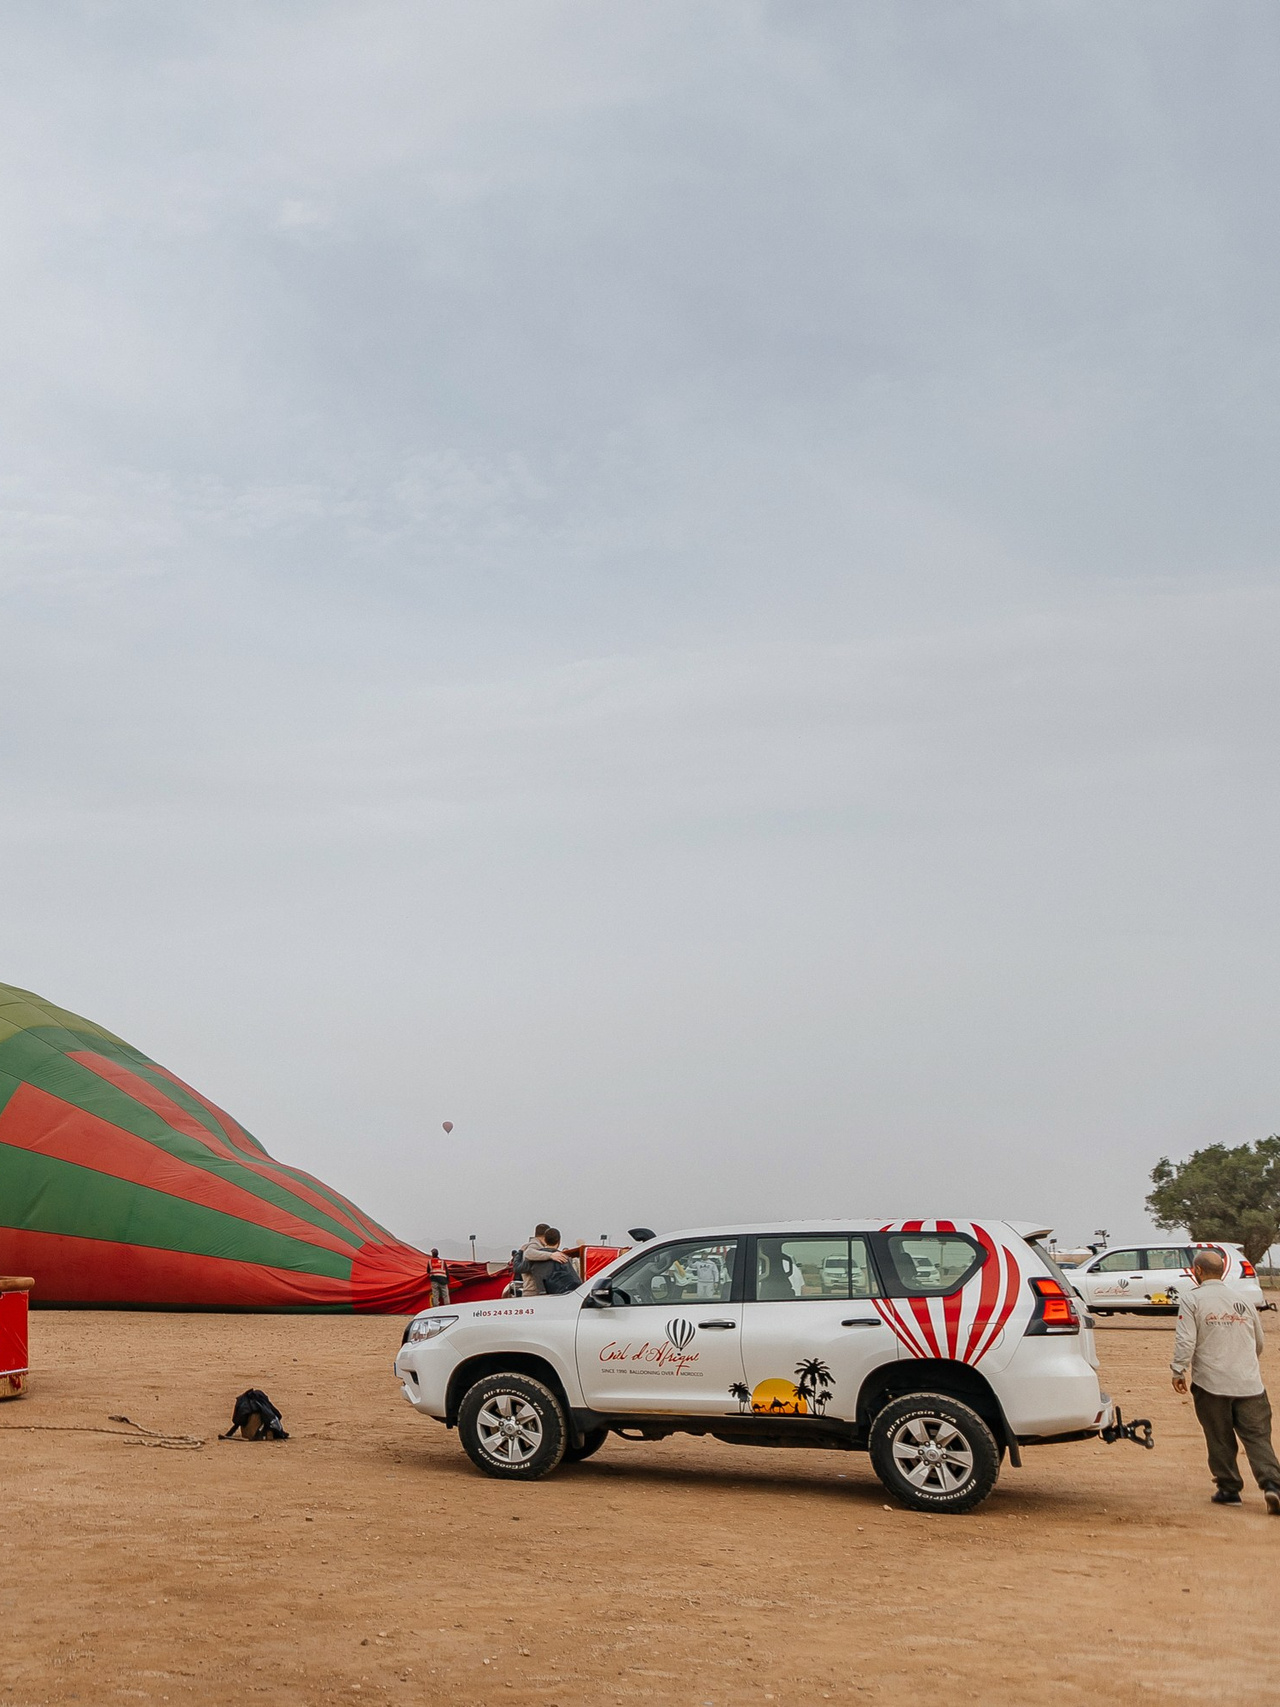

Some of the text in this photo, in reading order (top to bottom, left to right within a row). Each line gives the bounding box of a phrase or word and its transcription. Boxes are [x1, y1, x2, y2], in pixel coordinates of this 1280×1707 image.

[483, 1388, 531, 1400] All-Terrain
[886, 1410, 935, 1439] All-Terrain
[477, 1448, 531, 1470] BFGoodrich
[914, 1479, 977, 1501] BFGoodrich
